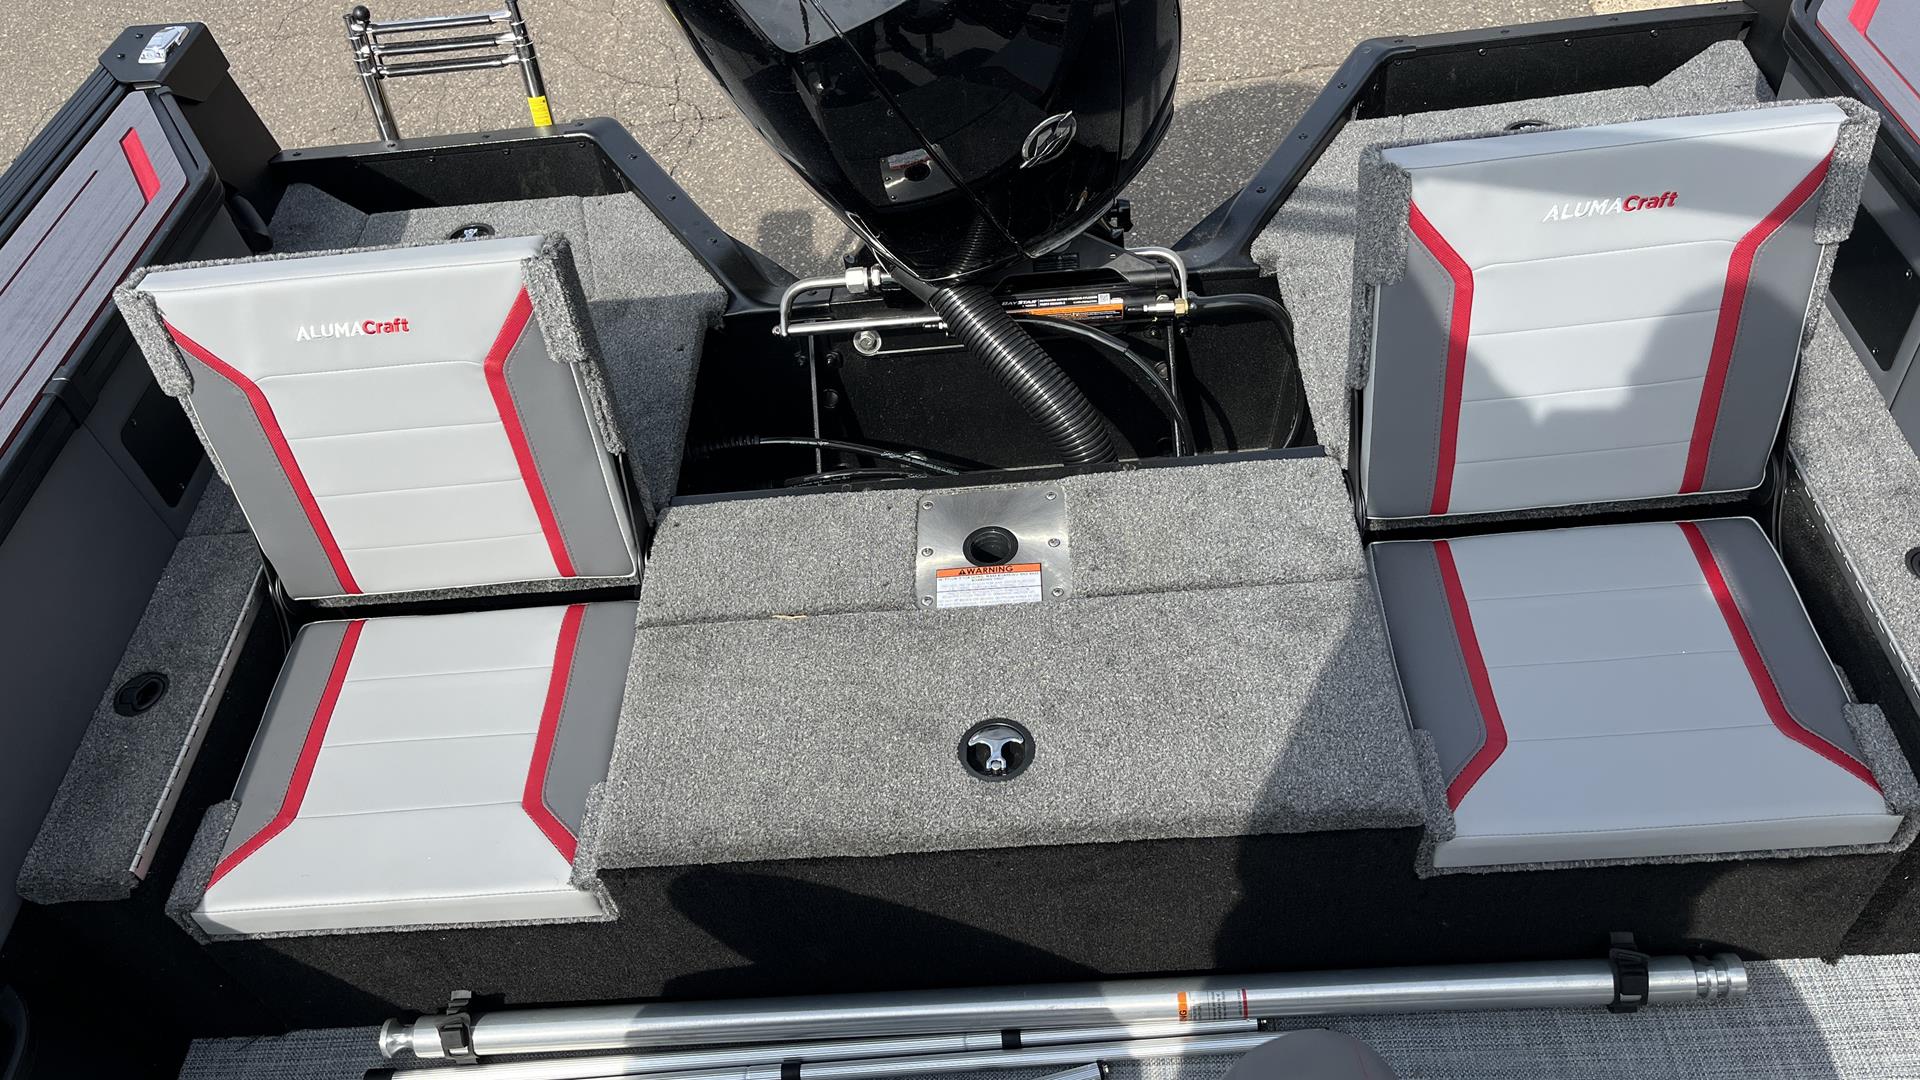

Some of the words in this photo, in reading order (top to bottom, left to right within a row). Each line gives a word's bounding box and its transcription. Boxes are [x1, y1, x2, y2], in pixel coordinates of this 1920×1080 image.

[1542, 191, 1679, 222] ALUMACraft
[296, 317, 410, 341] ALUMACraft
[966, 565, 1014, 575] WARNING
